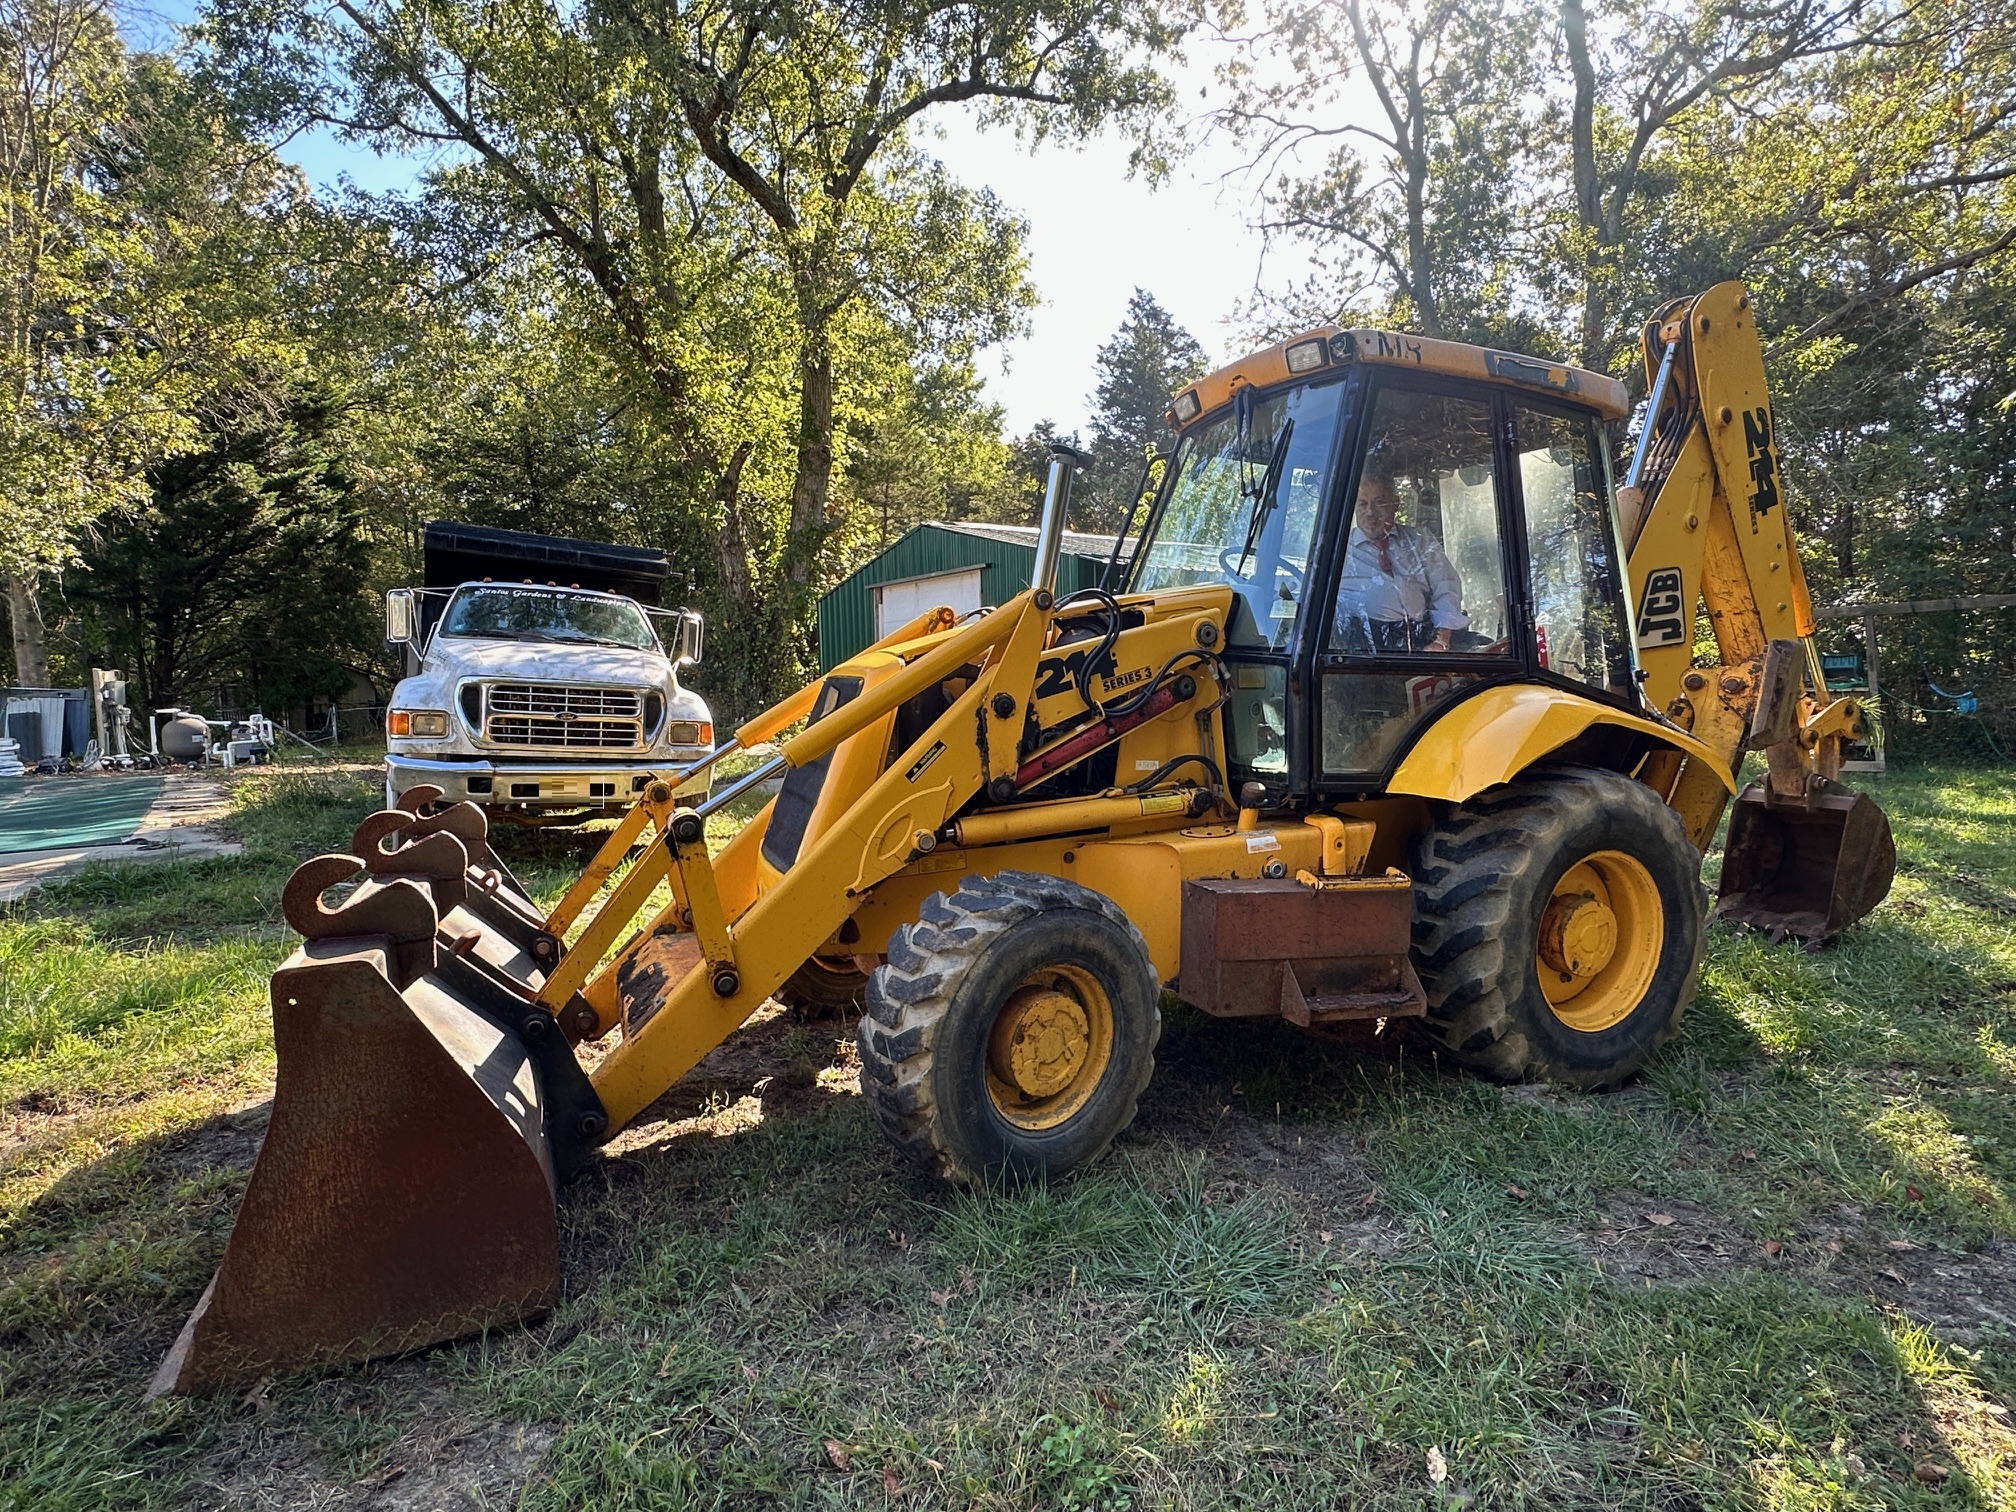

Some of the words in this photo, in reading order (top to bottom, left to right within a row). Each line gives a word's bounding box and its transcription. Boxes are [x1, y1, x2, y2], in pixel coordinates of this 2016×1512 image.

[1743, 407, 1778, 517] 214
[512, 590, 552, 599] Gardens
[1639, 573, 1682, 641] JCB
[1102, 671, 1142, 692] SERIES
[1144, 667, 1153, 679] 3
